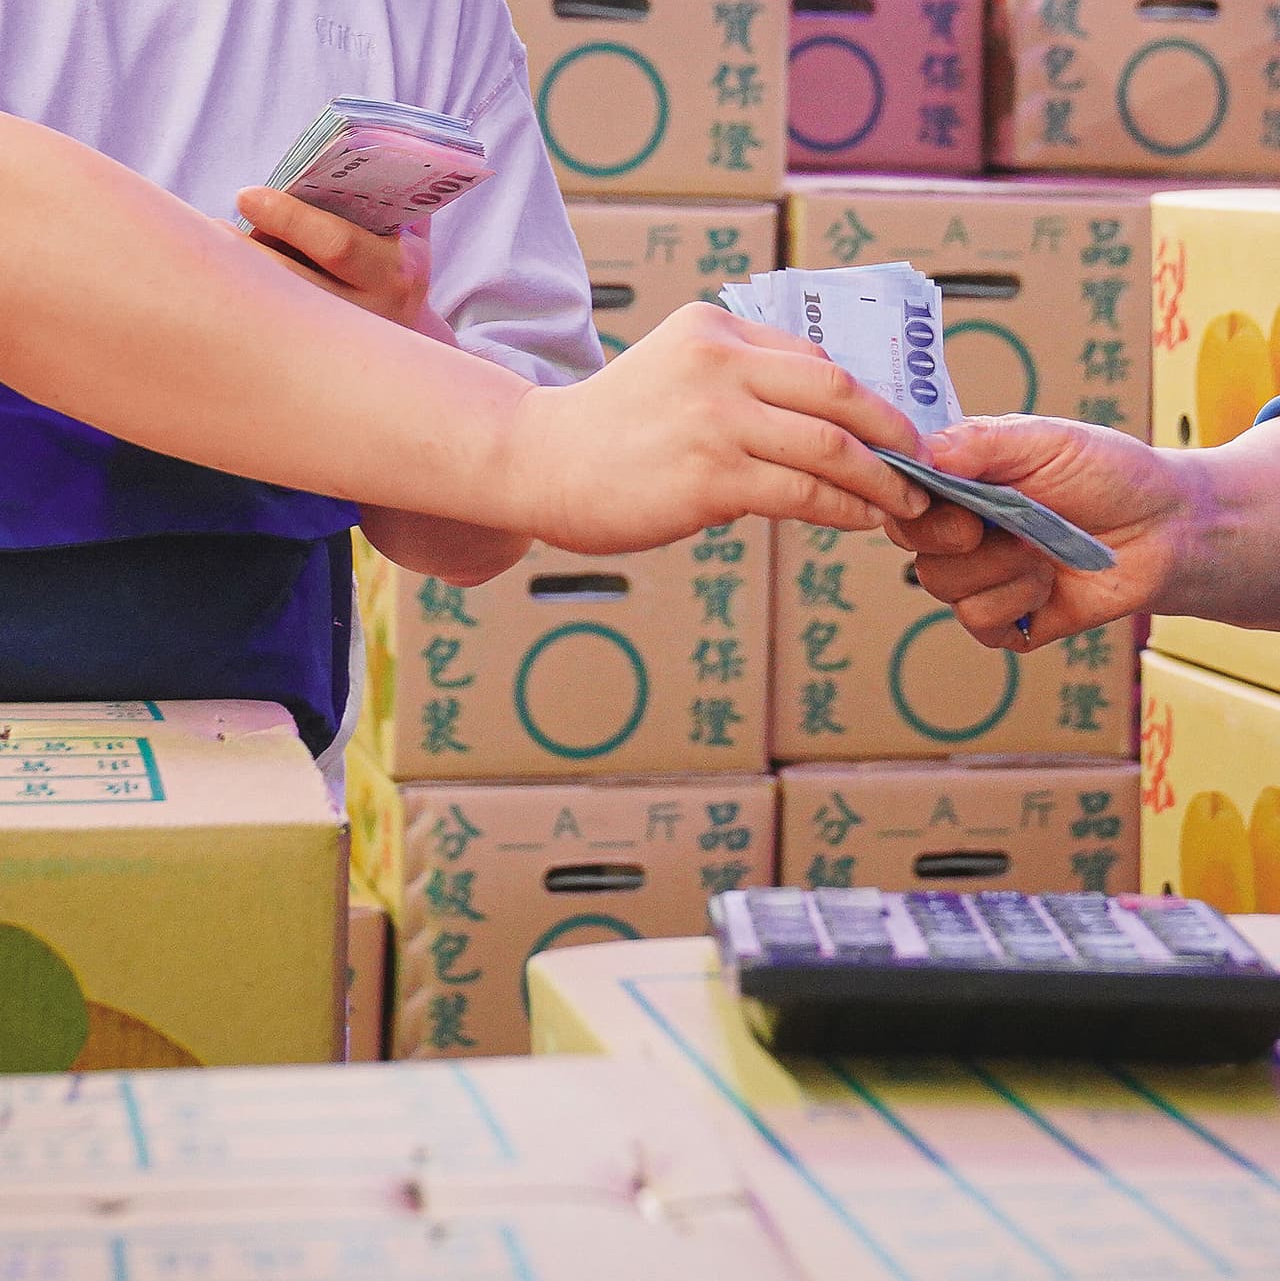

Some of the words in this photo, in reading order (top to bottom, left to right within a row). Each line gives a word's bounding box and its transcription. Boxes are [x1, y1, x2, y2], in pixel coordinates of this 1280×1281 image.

[410, 171, 477, 206] 100
[942, 216, 970, 246] A
[903, 299, 938, 406] 1000
[552, 806, 583, 839] A
[646, 801, 684, 841] 斤
[928, 795, 959, 826] A
[1021, 789, 1056, 827] 斤
[425, 803, 486, 1050] 分級包裝
